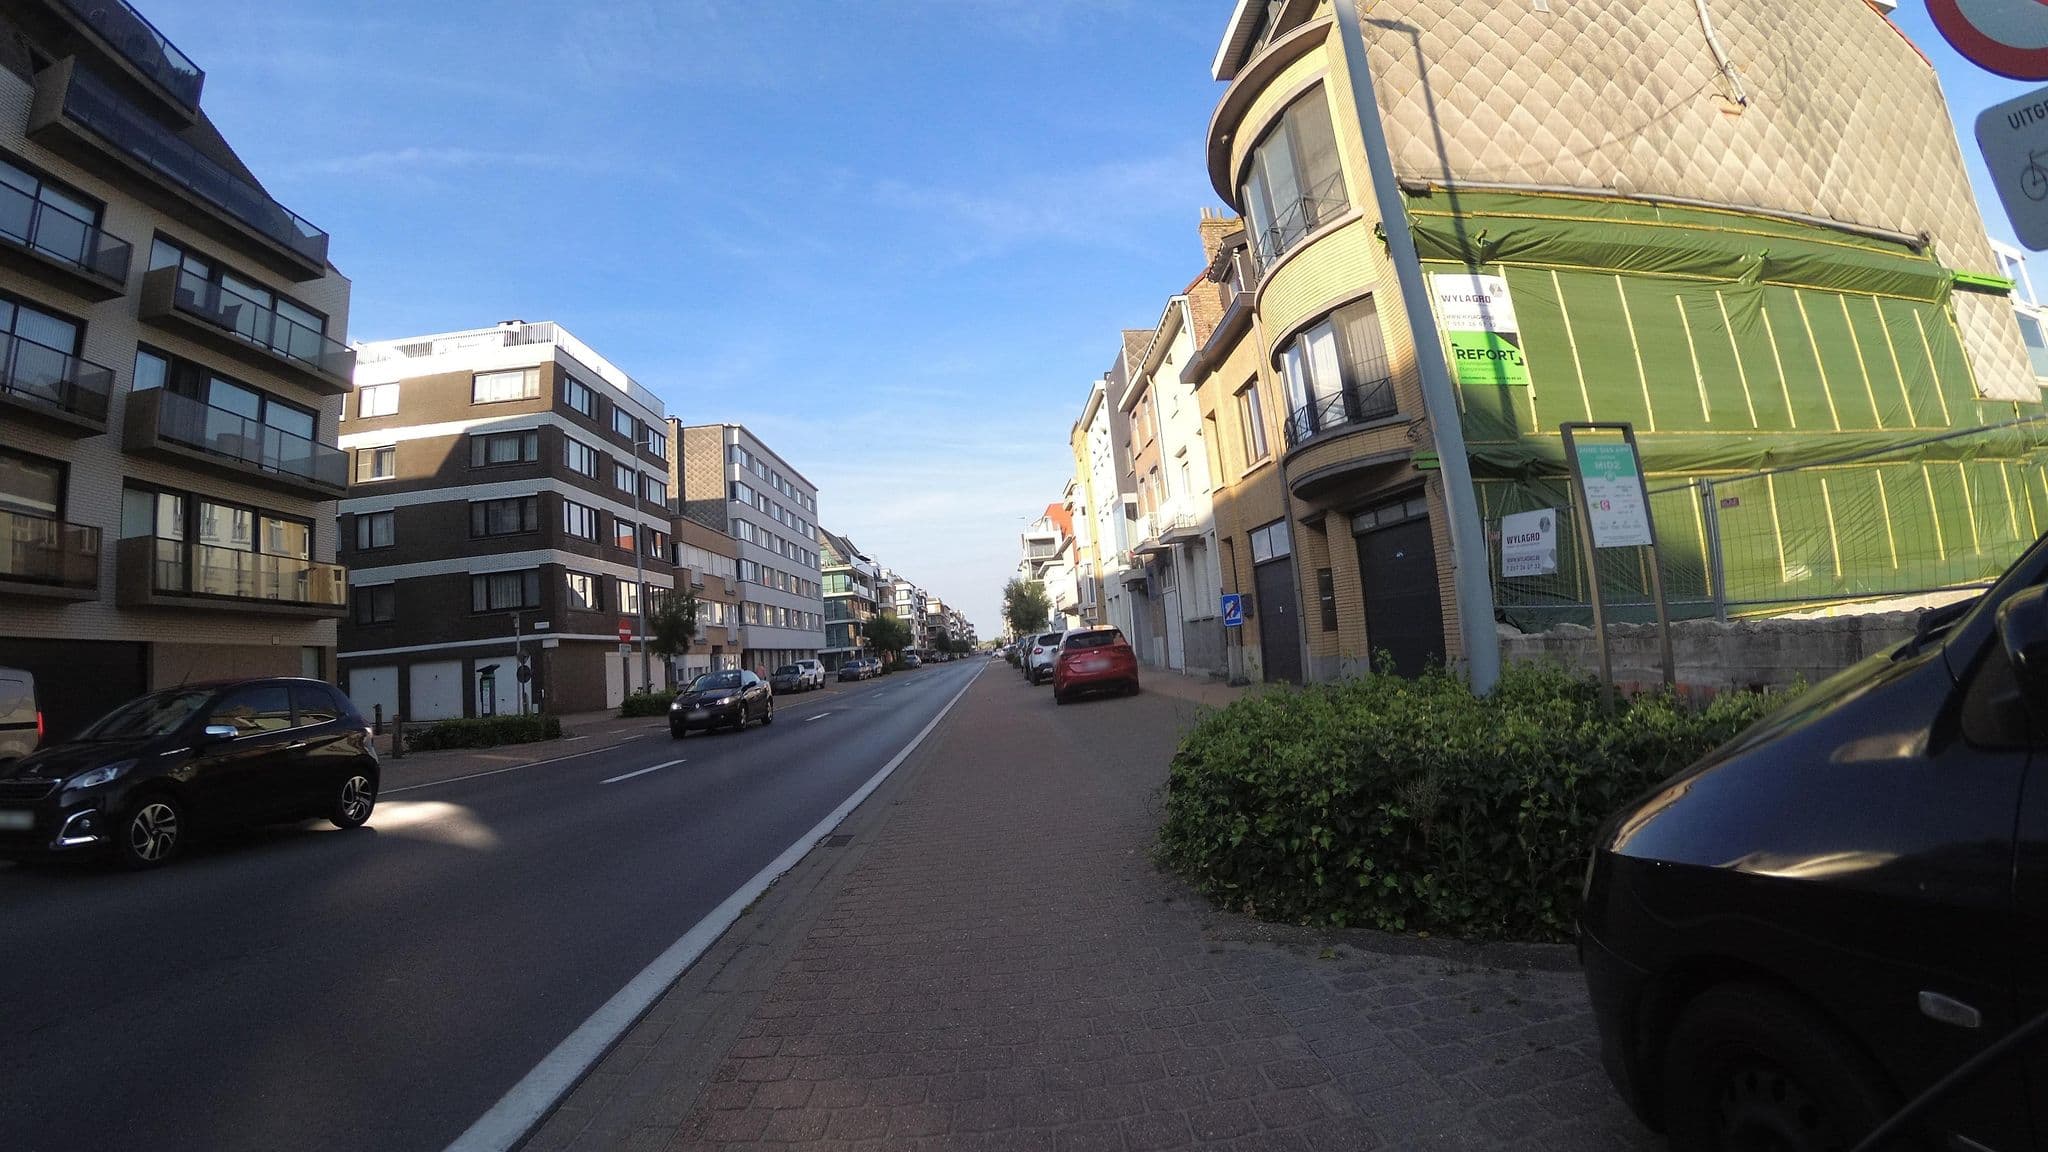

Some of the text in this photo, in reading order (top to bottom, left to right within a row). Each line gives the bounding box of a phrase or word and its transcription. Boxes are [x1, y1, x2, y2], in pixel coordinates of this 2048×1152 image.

[1441, 294, 1491, 303] WYLAGRO
[1456, 349, 1515, 360] REFORT
[1507, 532, 1540, 544] WYLAGRO
